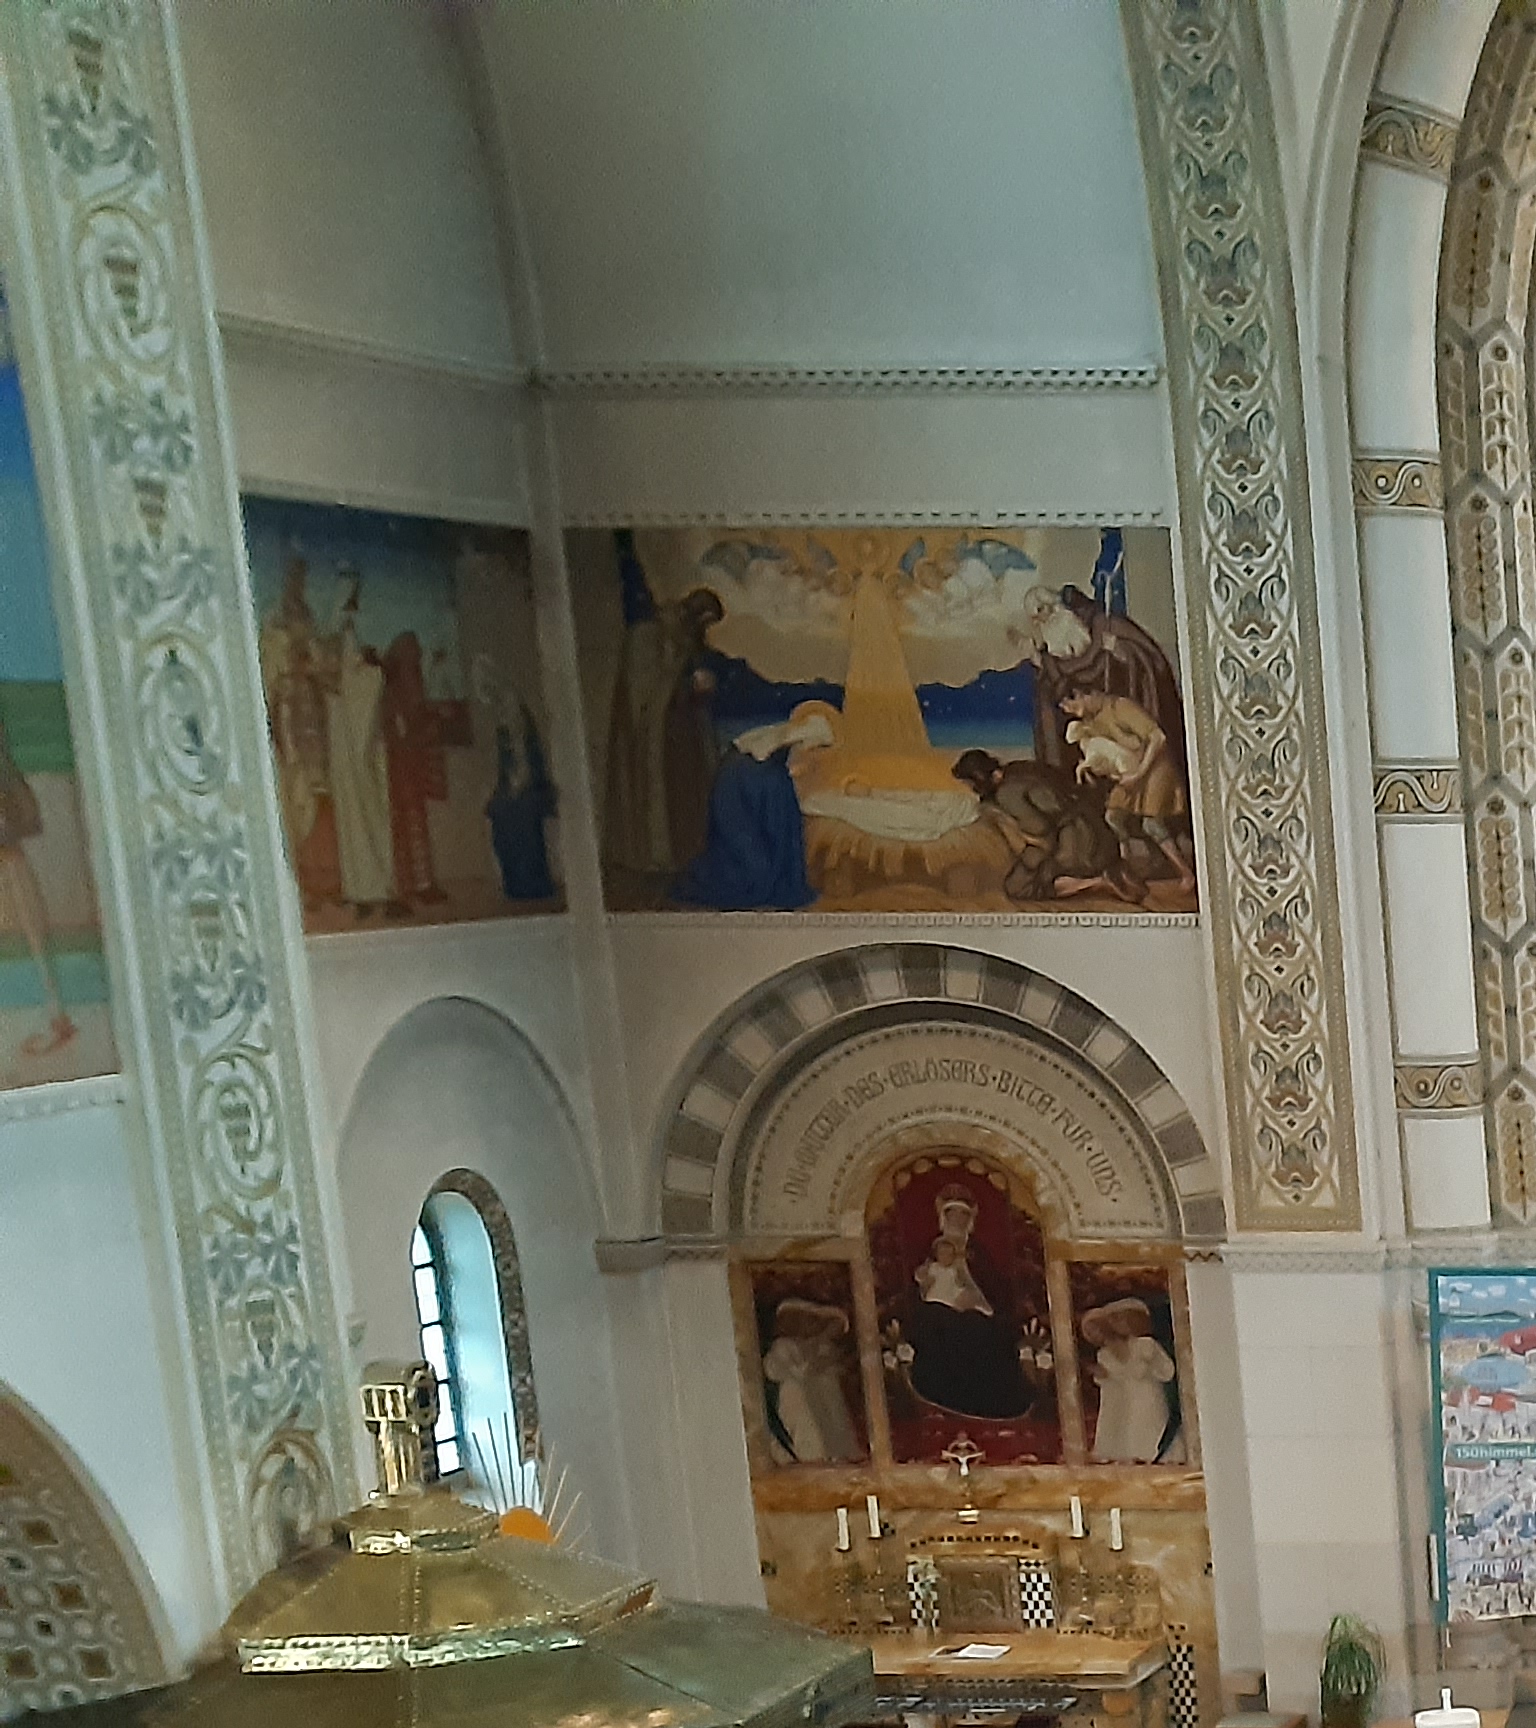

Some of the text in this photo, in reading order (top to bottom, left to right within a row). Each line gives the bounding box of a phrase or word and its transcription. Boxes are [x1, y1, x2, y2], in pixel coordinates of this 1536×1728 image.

[844, 1071, 885, 1109] DES
[997, 1069, 1056, 1115] BITTE
[1086, 1149, 1123, 1196] UNS
